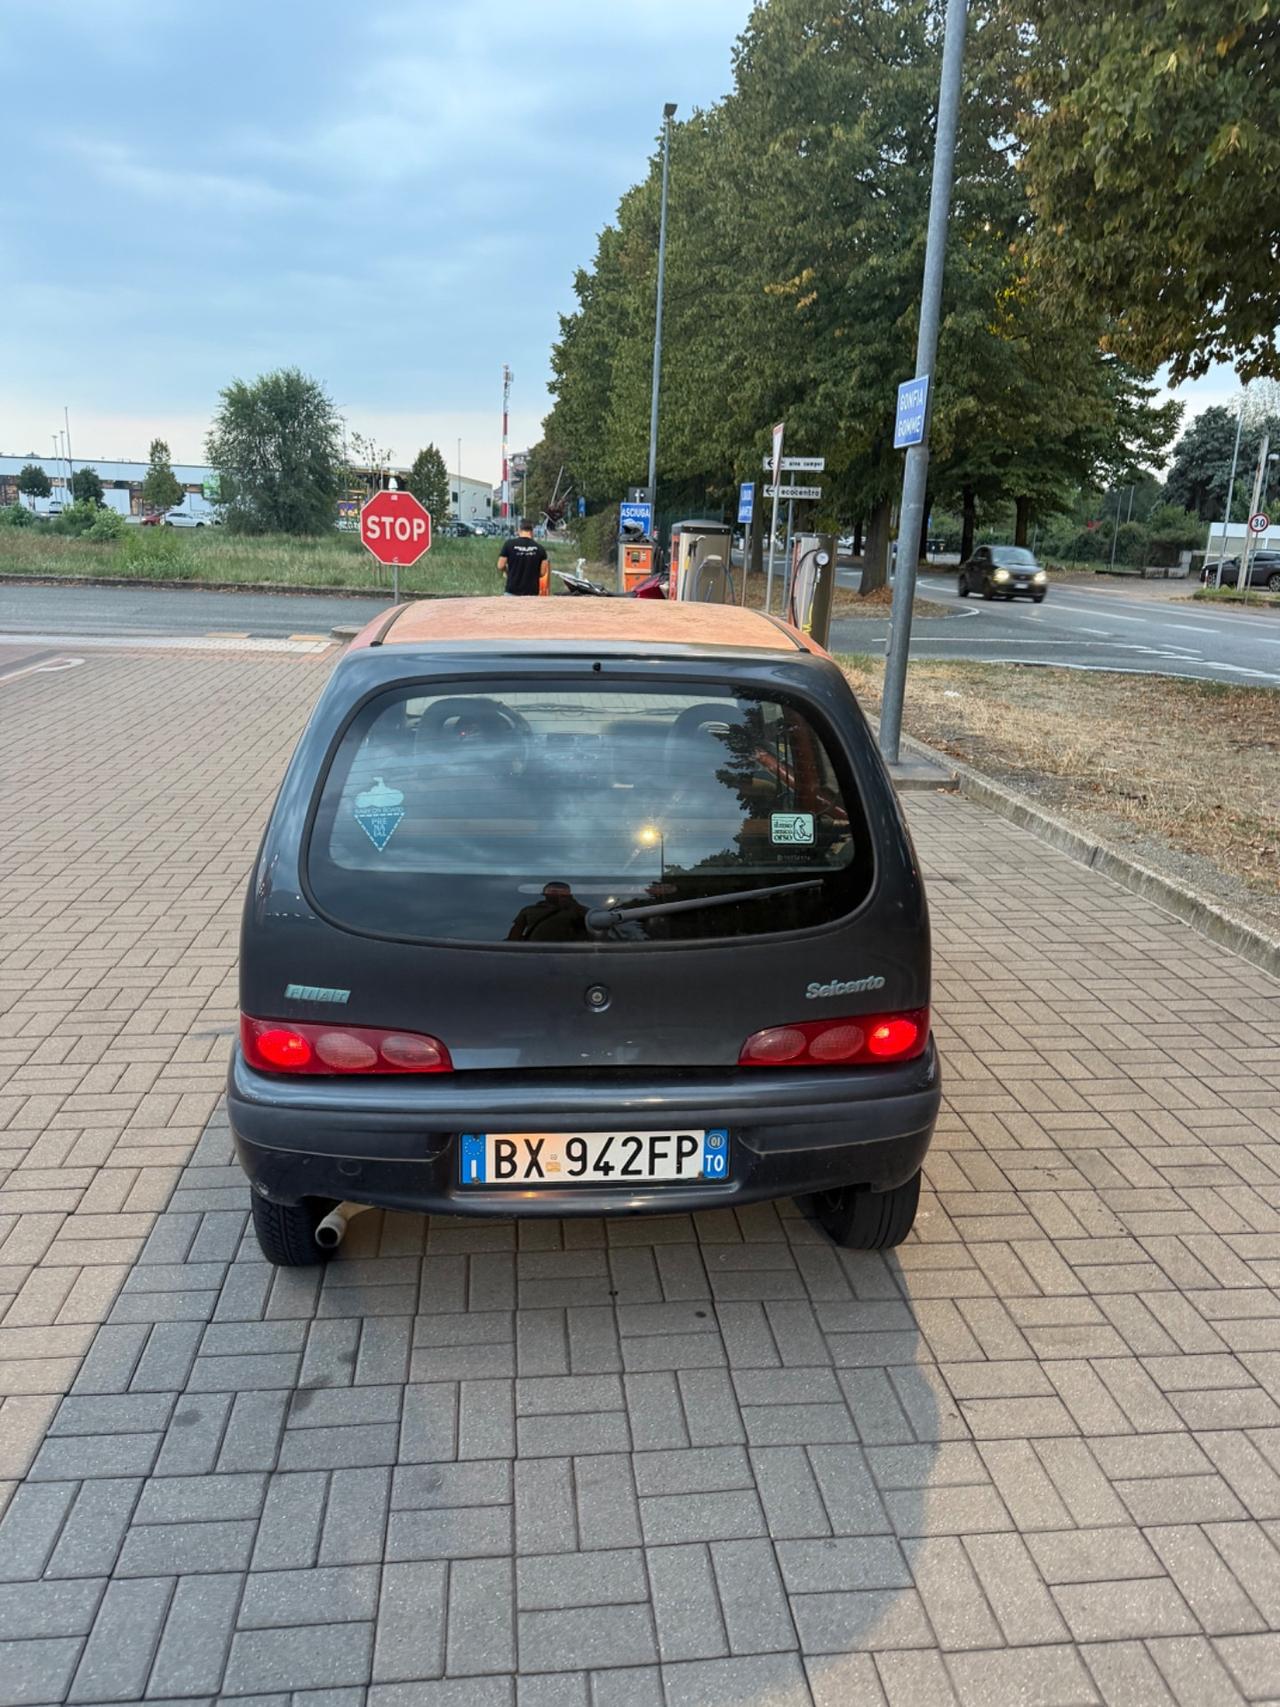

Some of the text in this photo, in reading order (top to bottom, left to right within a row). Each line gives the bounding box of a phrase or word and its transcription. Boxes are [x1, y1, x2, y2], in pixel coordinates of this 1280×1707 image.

[900, 388, 924, 411] GONFIA
[898, 415, 921, 437] GOMME
[781, 489, 820, 497] ecocentro
[621, 508, 650, 517] ASCIUGA
[366, 515, 426, 542] STOP
[1254, 518, 1266, 528] 30
[288, 985, 348, 1002] FIAT
[805, 975, 886, 999] Seicento
[494, 1138, 545, 1179] BX
[565, 1135, 699, 1176] 942FP
[705, 1154, 724, 1173] TO
